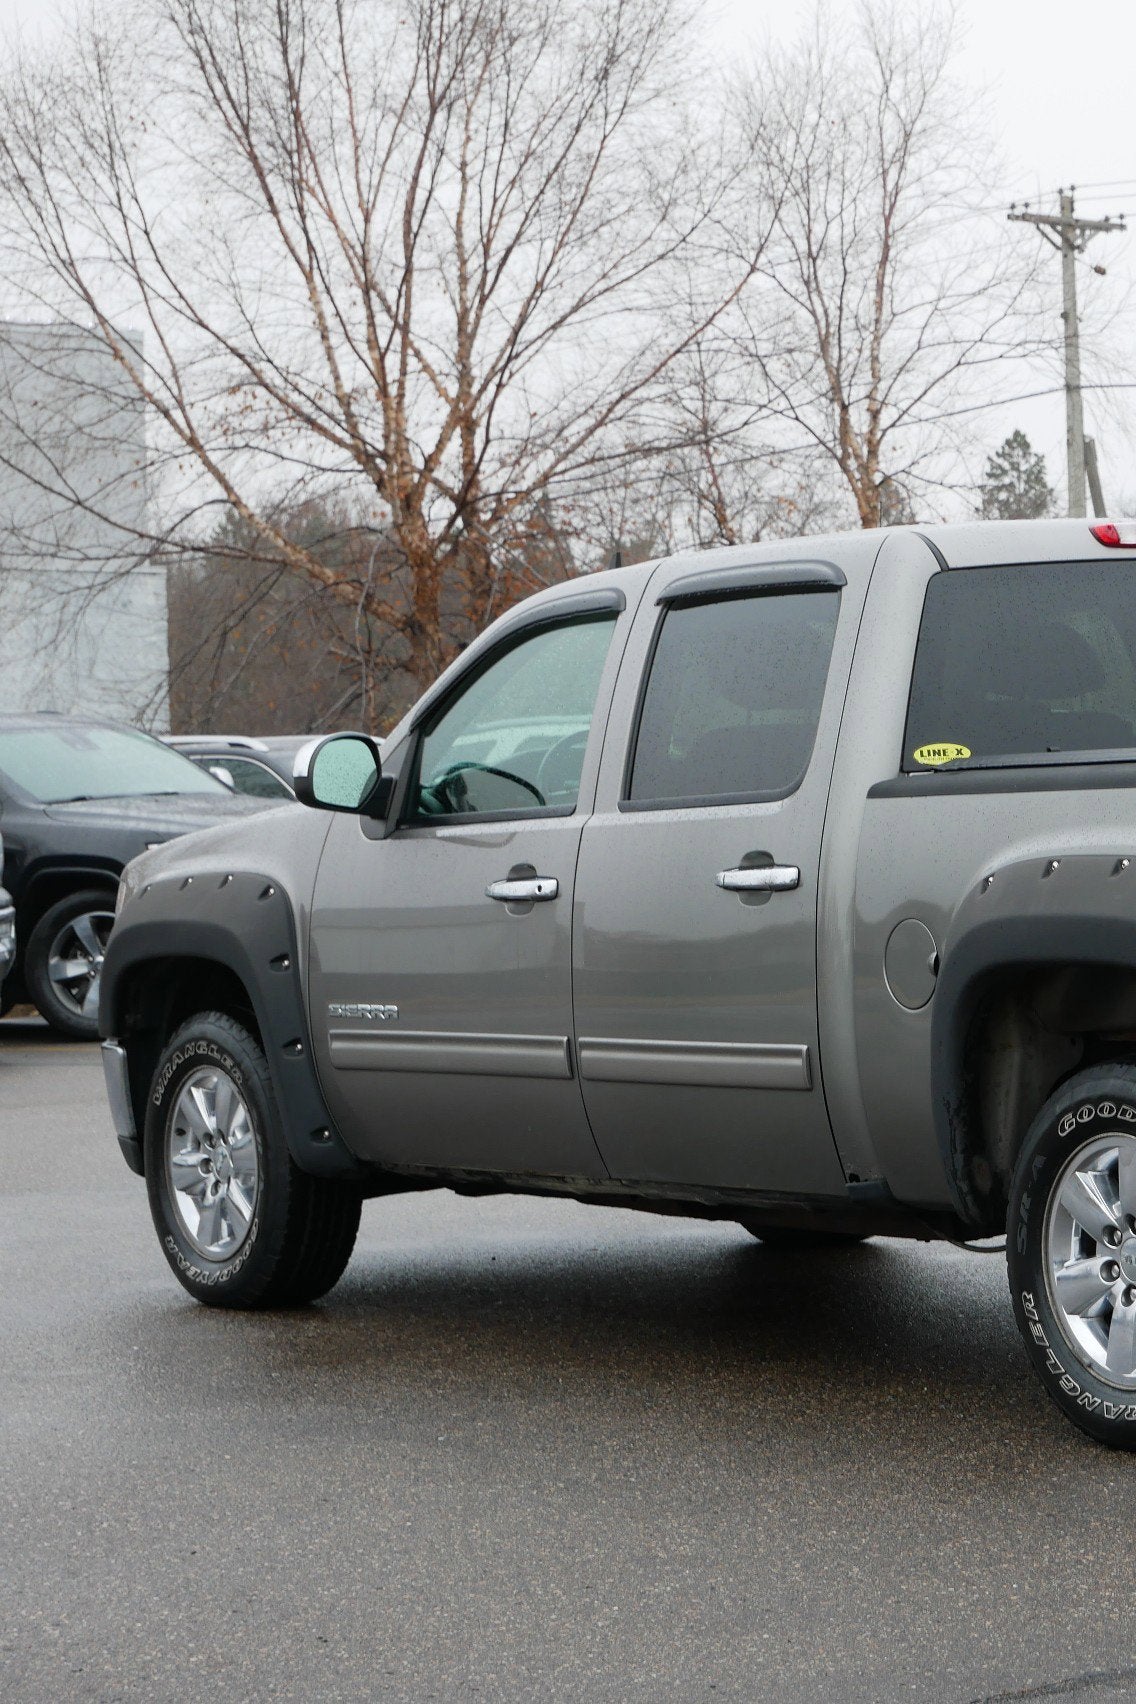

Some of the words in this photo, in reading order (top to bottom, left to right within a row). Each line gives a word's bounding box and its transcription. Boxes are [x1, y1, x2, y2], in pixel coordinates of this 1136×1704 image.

[919, 748, 949, 757] LINE
[955, 748, 964, 756] X
[328, 1003, 399, 1019] SIERRA
[153, 1041, 243, 1106] WRANGLER
[164, 1218, 259, 1285] GOODYEAR
